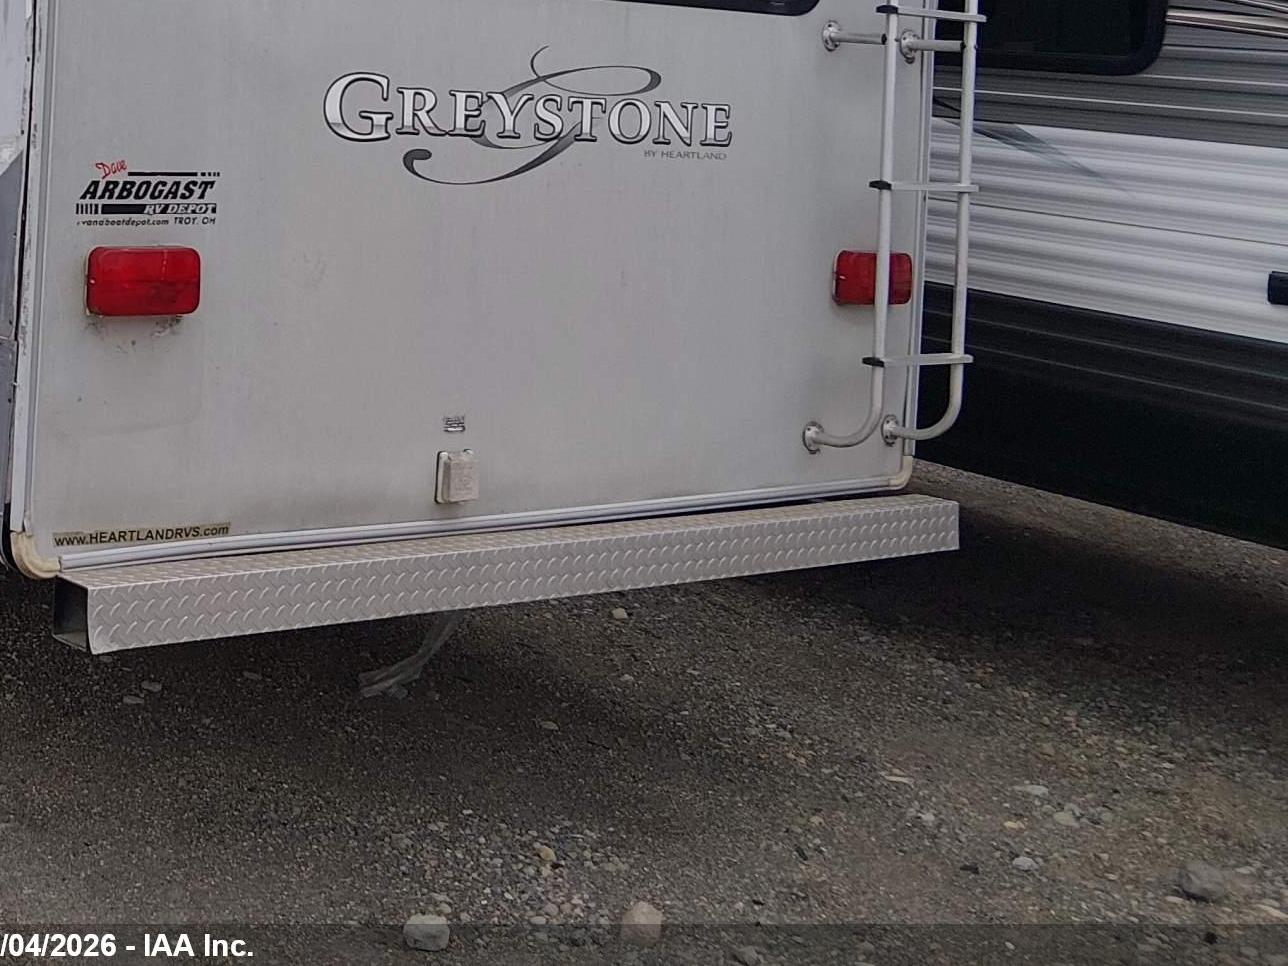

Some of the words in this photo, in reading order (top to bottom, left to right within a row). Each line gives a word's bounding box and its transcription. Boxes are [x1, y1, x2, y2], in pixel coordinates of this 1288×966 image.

[323, 71, 733, 147] GREYSTONE
[661, 150, 727, 160] HEARTLAND
[95, 159, 128, 180] Dave
[79, 180, 215, 200] ARBOGAST
[143, 204, 165, 214] RV
[166, 204, 216, 214] DEPOT
[202, 216, 216, 225] OH
[54, 526, 229, 547] www.HEARTLANDRVS.com
